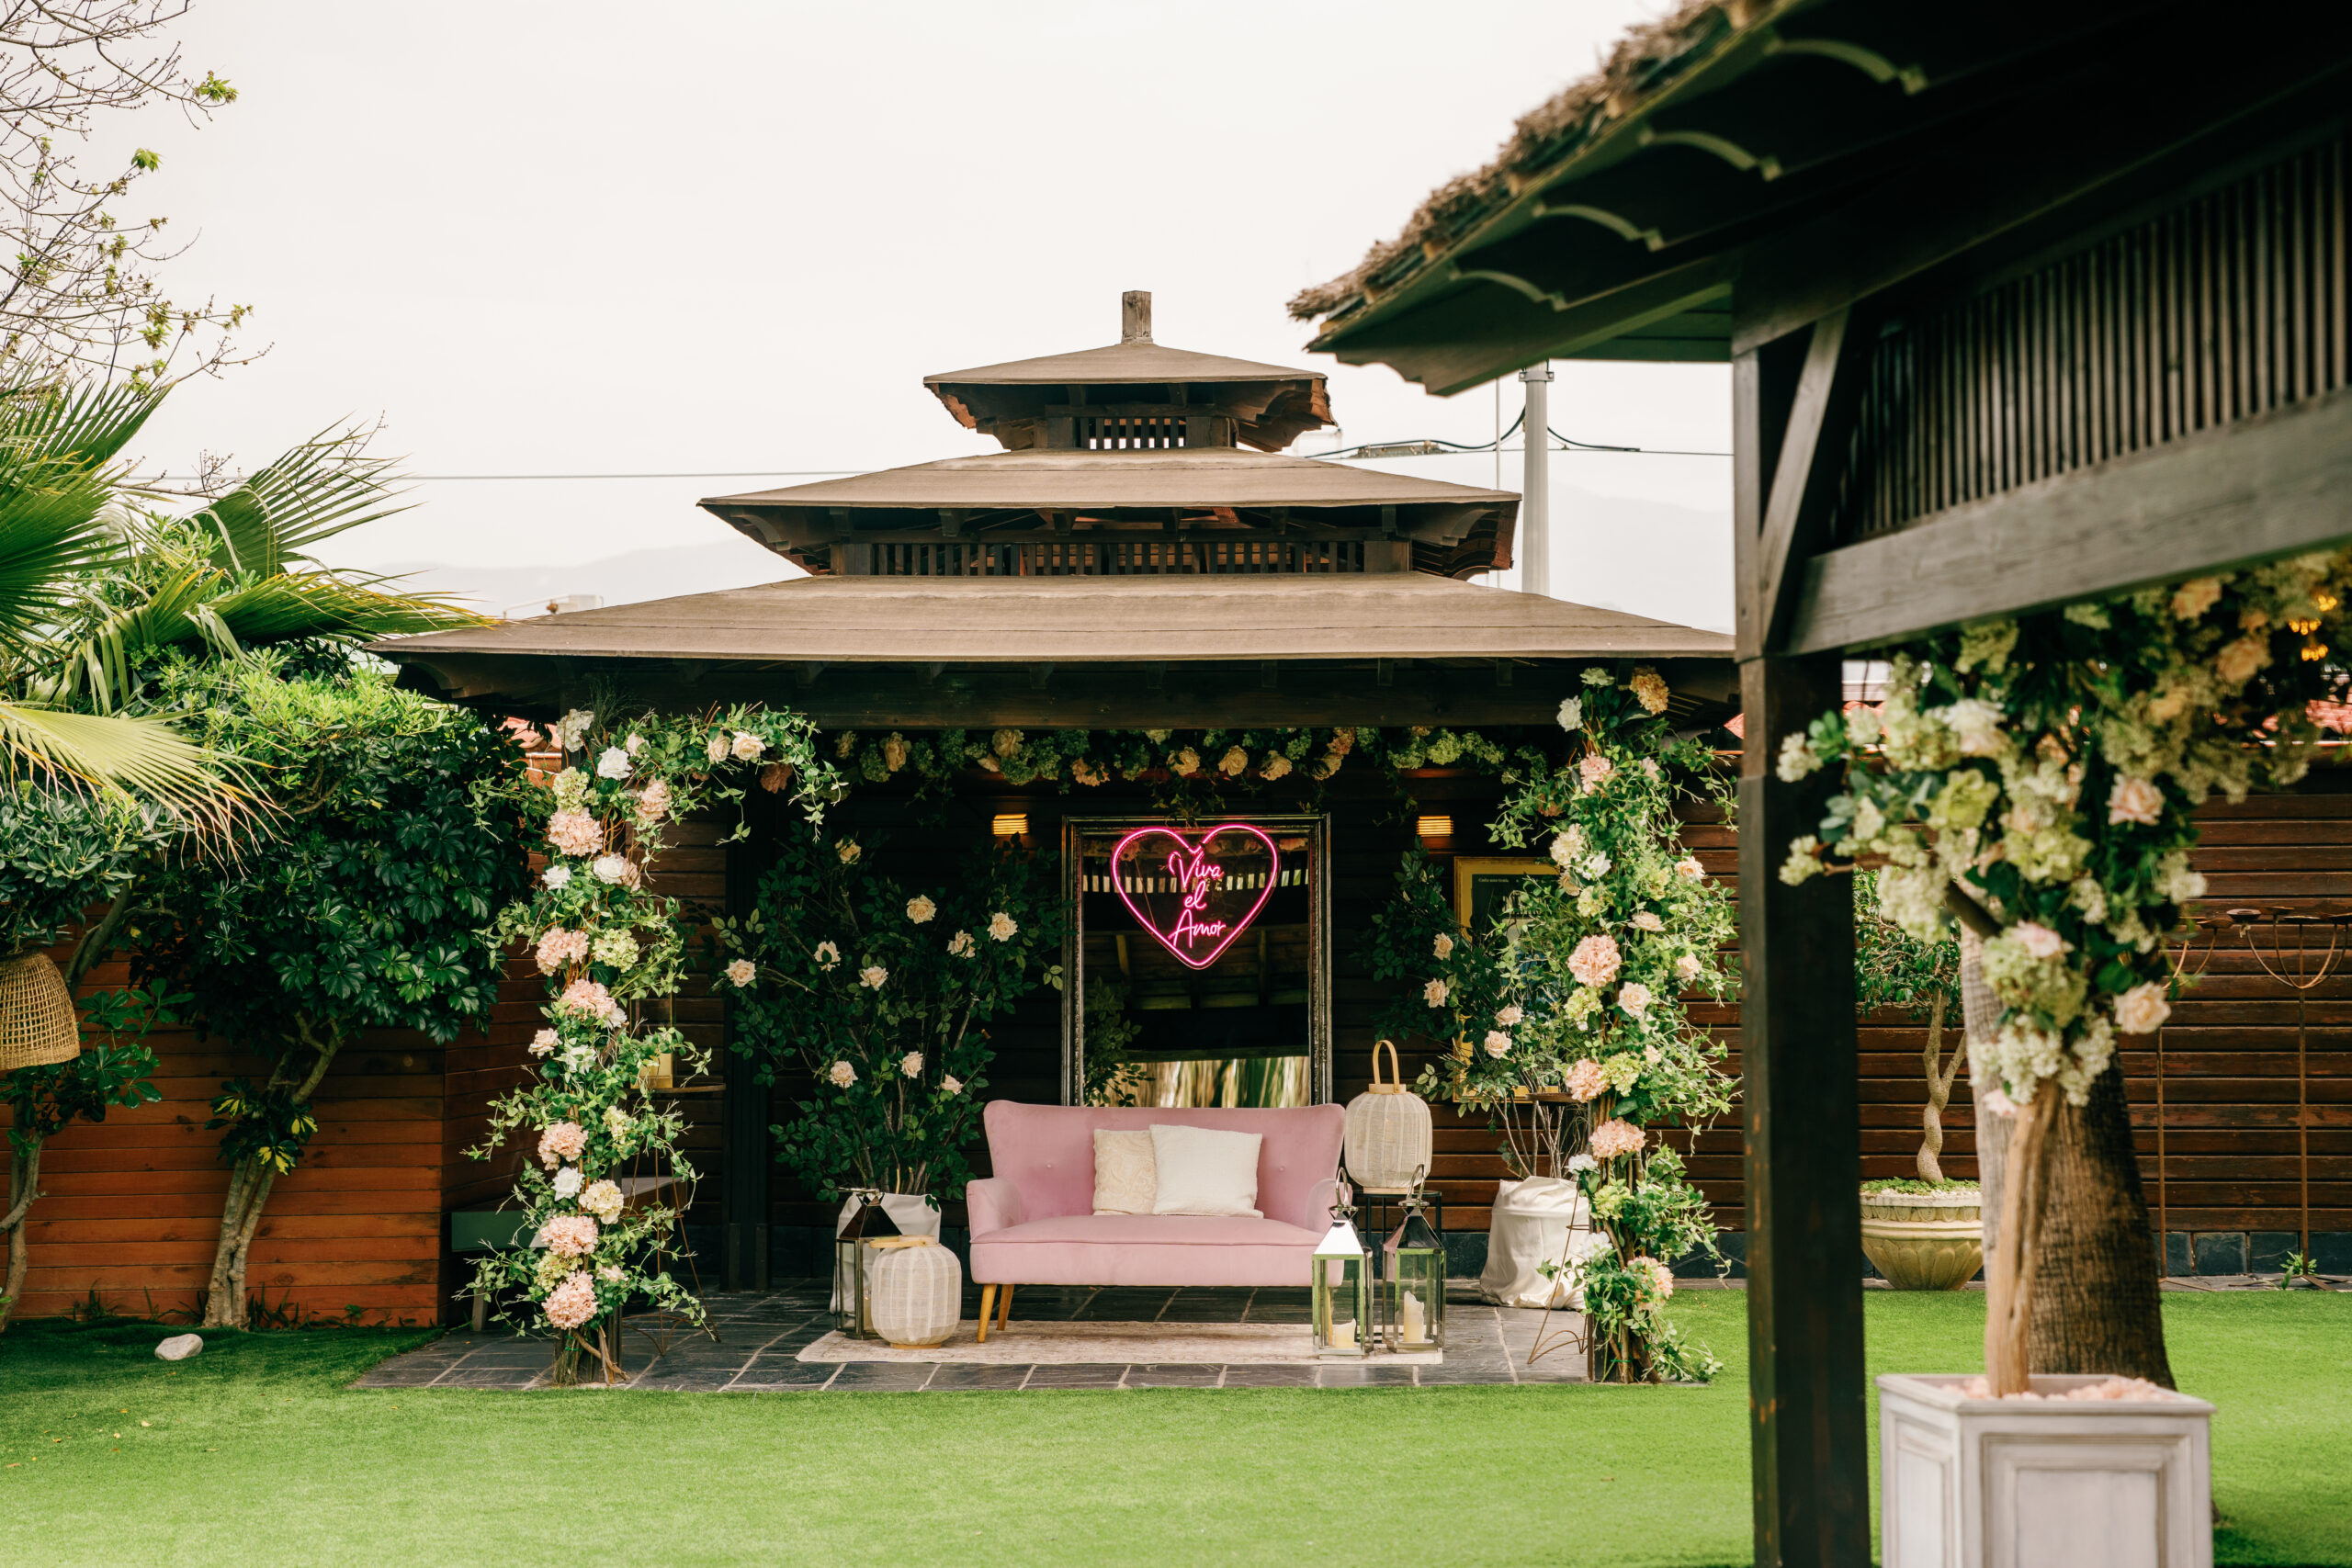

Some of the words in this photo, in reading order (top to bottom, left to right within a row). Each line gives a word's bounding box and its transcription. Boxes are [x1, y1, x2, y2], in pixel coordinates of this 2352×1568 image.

[1169, 852, 1223, 887] Viva
[1184, 880, 1207, 908] el
[1168, 908, 1226, 948] Amor
